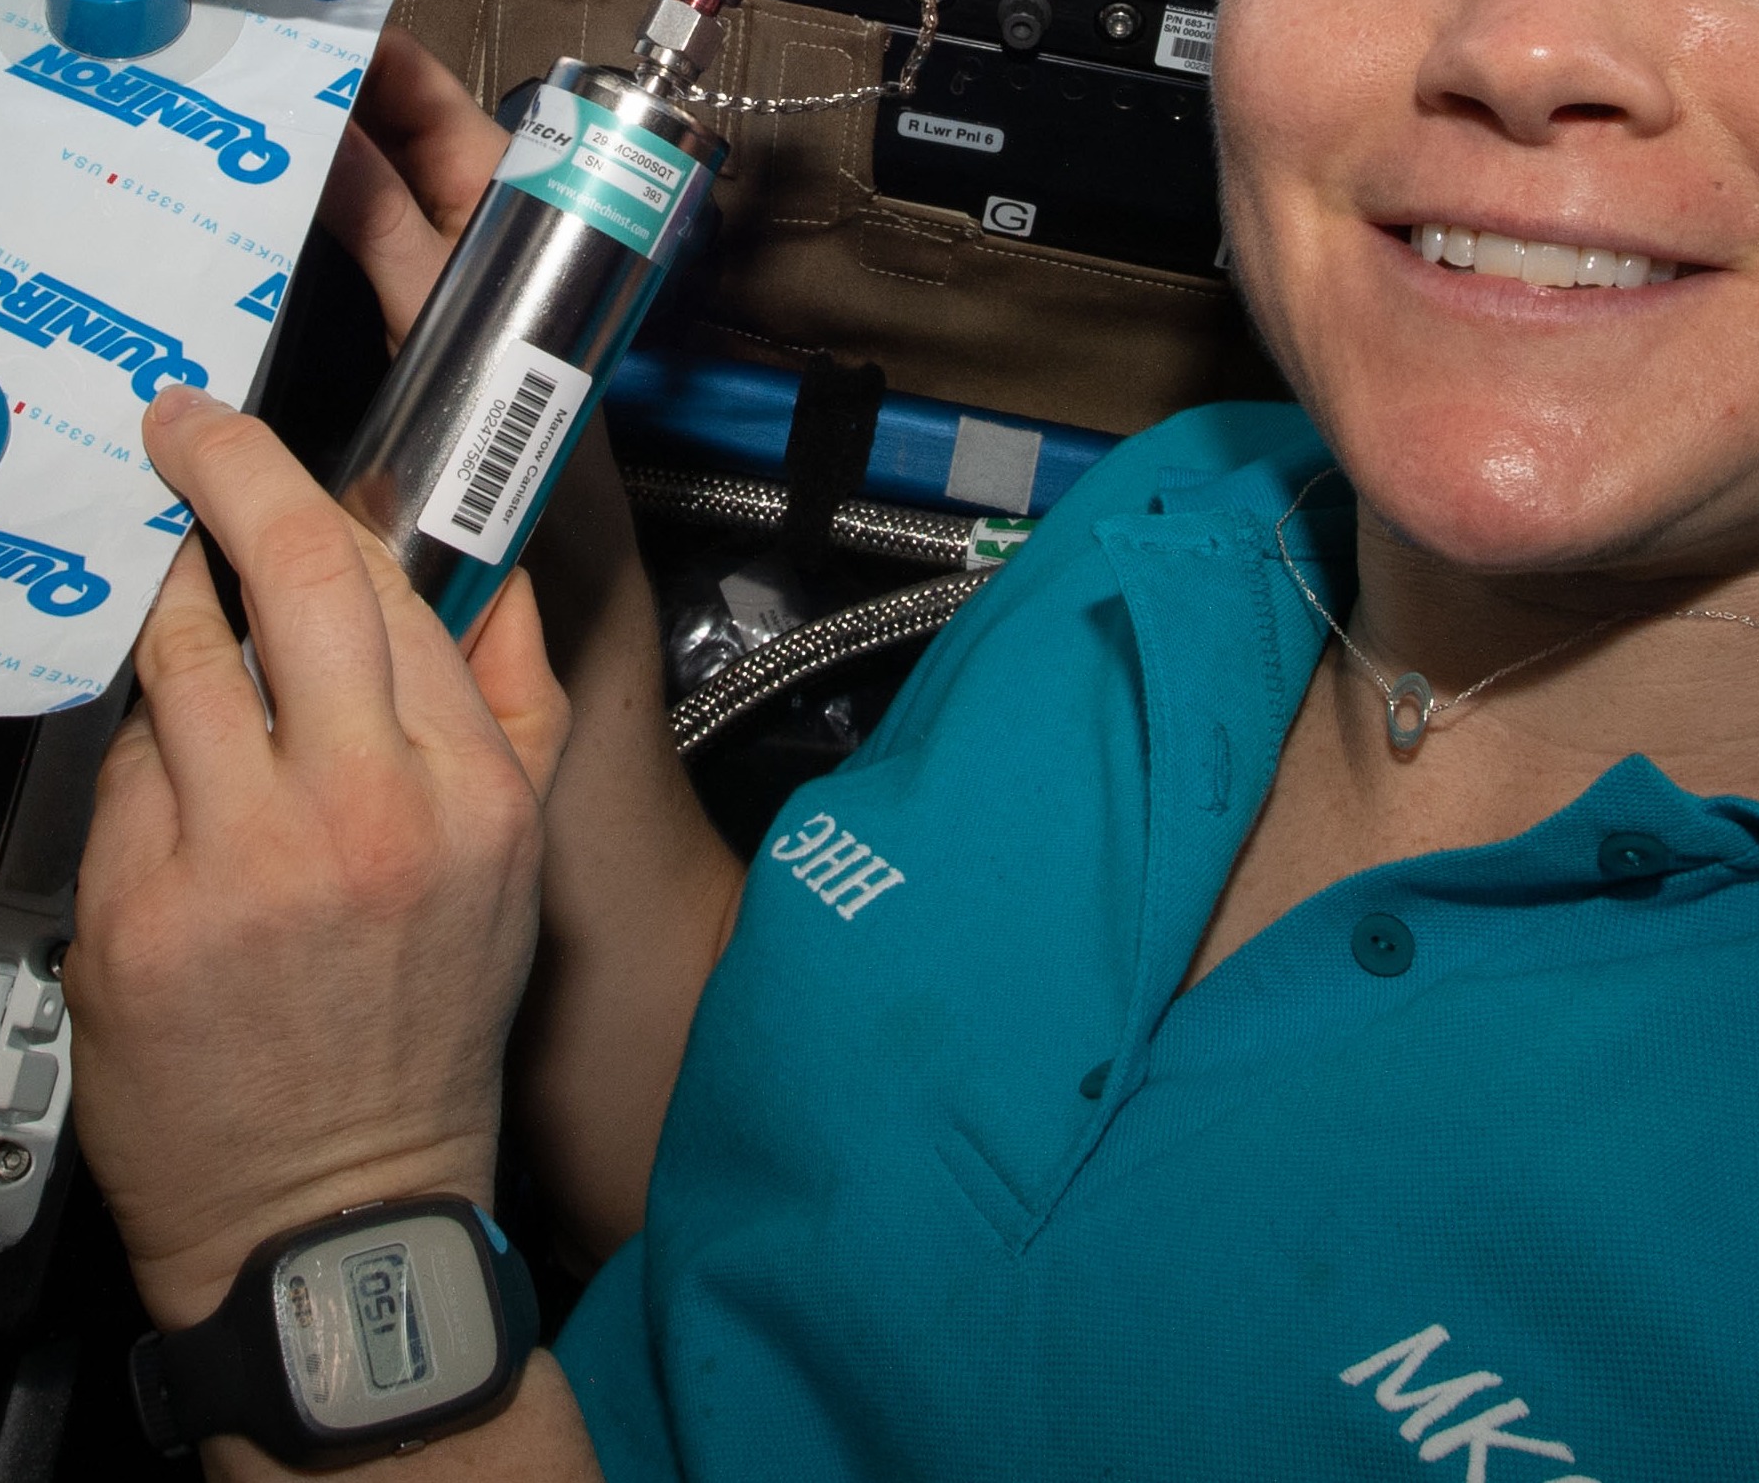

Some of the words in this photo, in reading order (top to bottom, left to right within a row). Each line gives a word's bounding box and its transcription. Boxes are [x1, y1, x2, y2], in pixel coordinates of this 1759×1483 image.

[908, 119, 919, 131] R
[922, 122, 954, 138] Lwr
[956, 126, 982, 143] Pnl
[984, 132, 994, 145] 6
[61, 147, 103, 177] USA
[121, 177, 185, 215] 53215
[642, 186, 663, 205] 393
[191, 212, 218, 234] WI
[990, 202, 1029, 231] G
[28, 406, 96, 450] 53215
[457, 398, 507, 482] 00247756C
[534, 408, 569, 462] Marrow
[101, 441, 131, 463] WI
[502, 464, 539, 526] Canister
